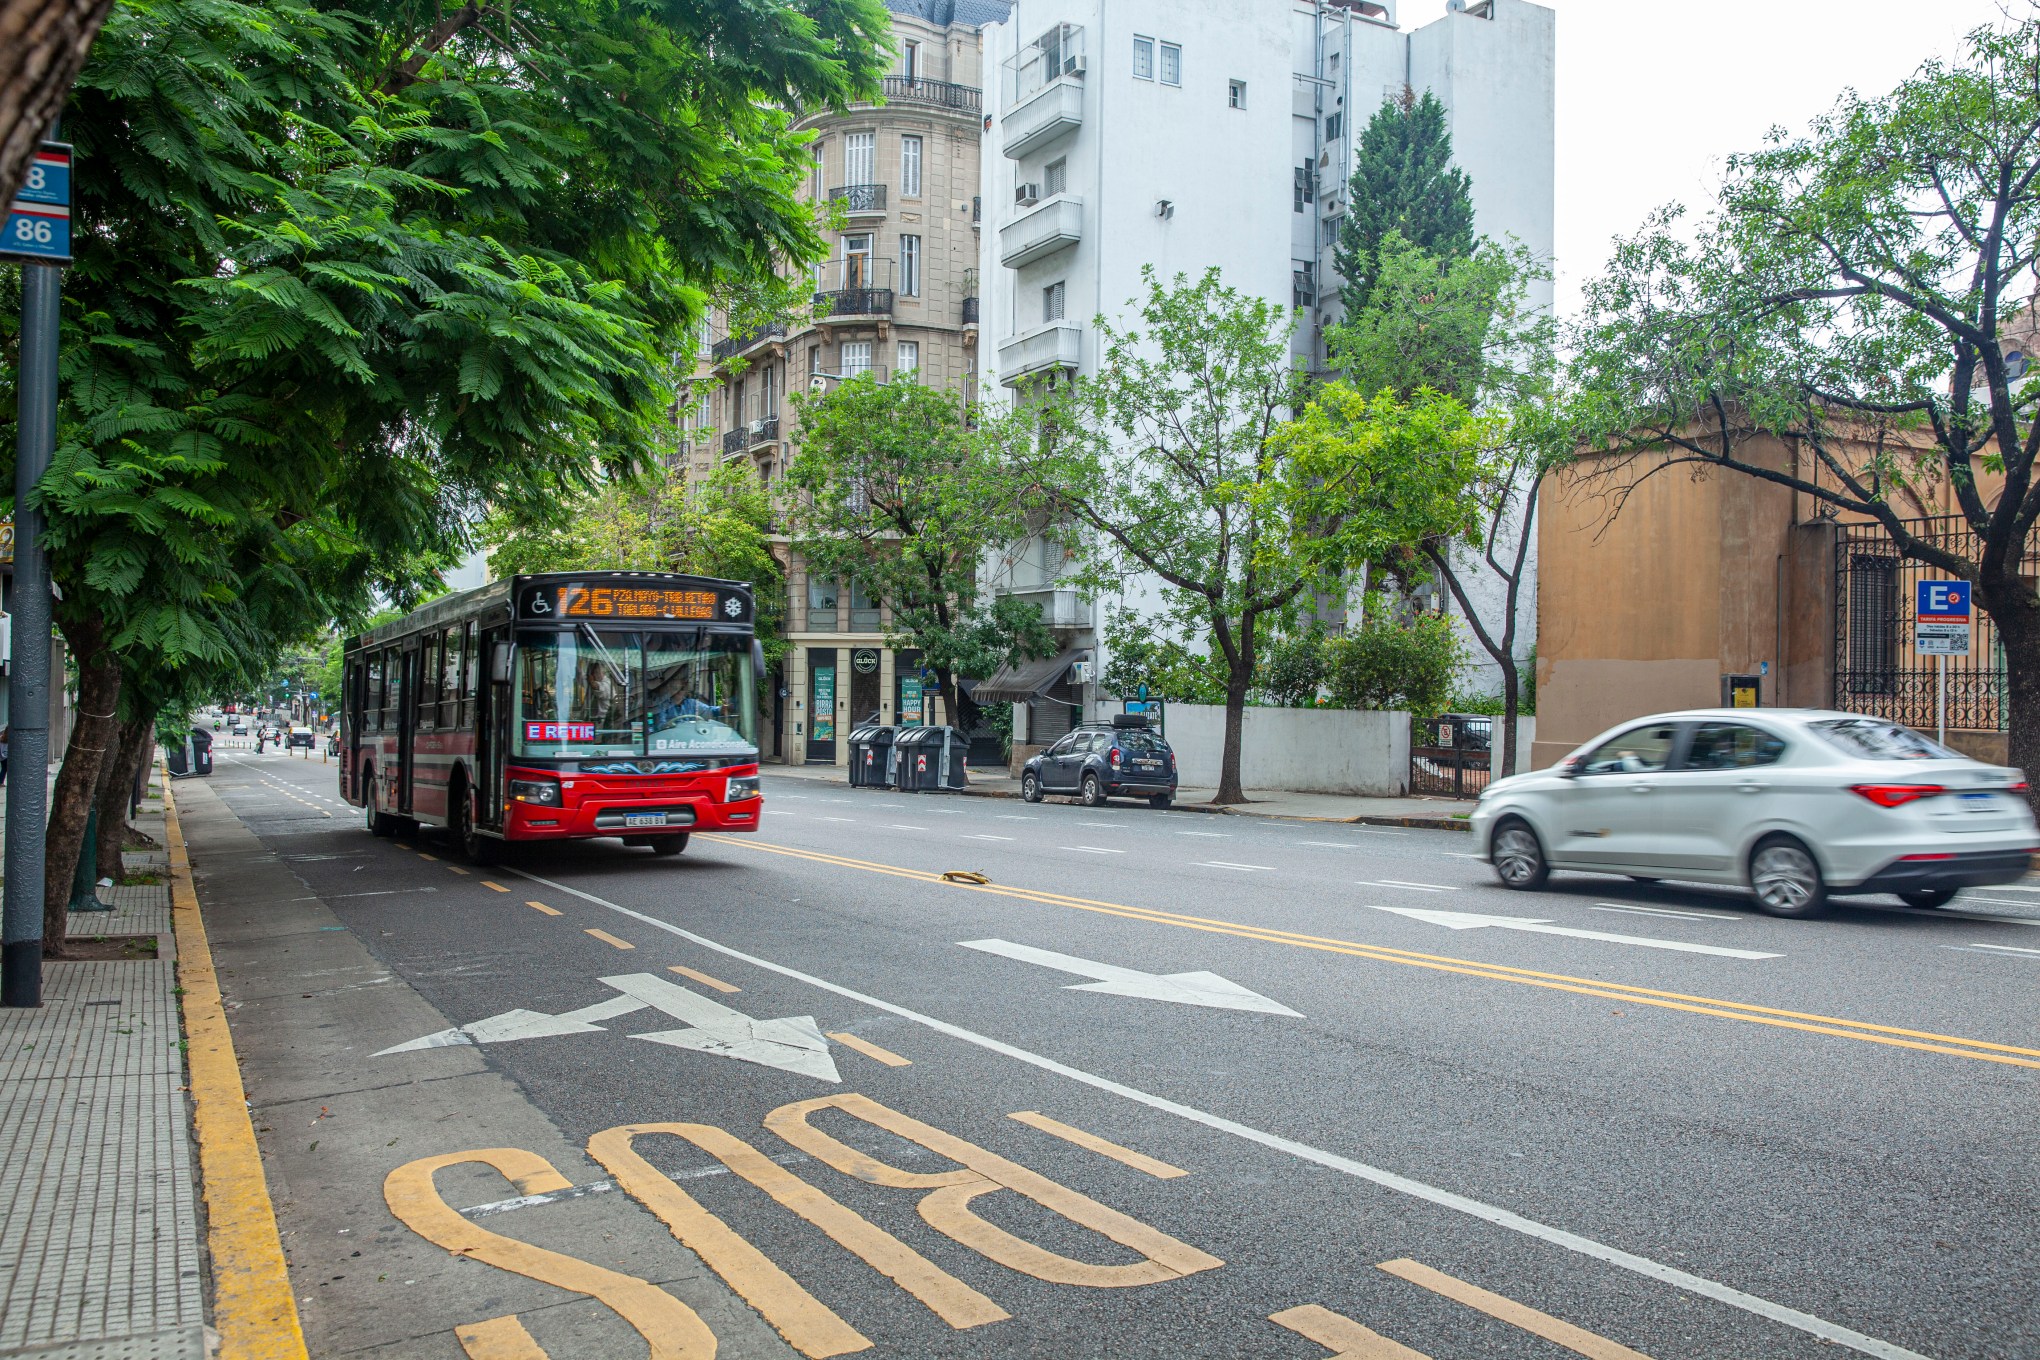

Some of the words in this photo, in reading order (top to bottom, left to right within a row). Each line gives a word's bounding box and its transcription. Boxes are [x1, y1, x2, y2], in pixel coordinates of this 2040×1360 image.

[25, 166, 46, 190] 8
[15, 218, 52, 243] 86
[557, 587, 613, 616] 126
[1930, 585, 1949, 610] E
[528, 725, 540, 738] E
[668, 739, 687, 749] Aire
[384, 1093, 1226, 1360] BUS
